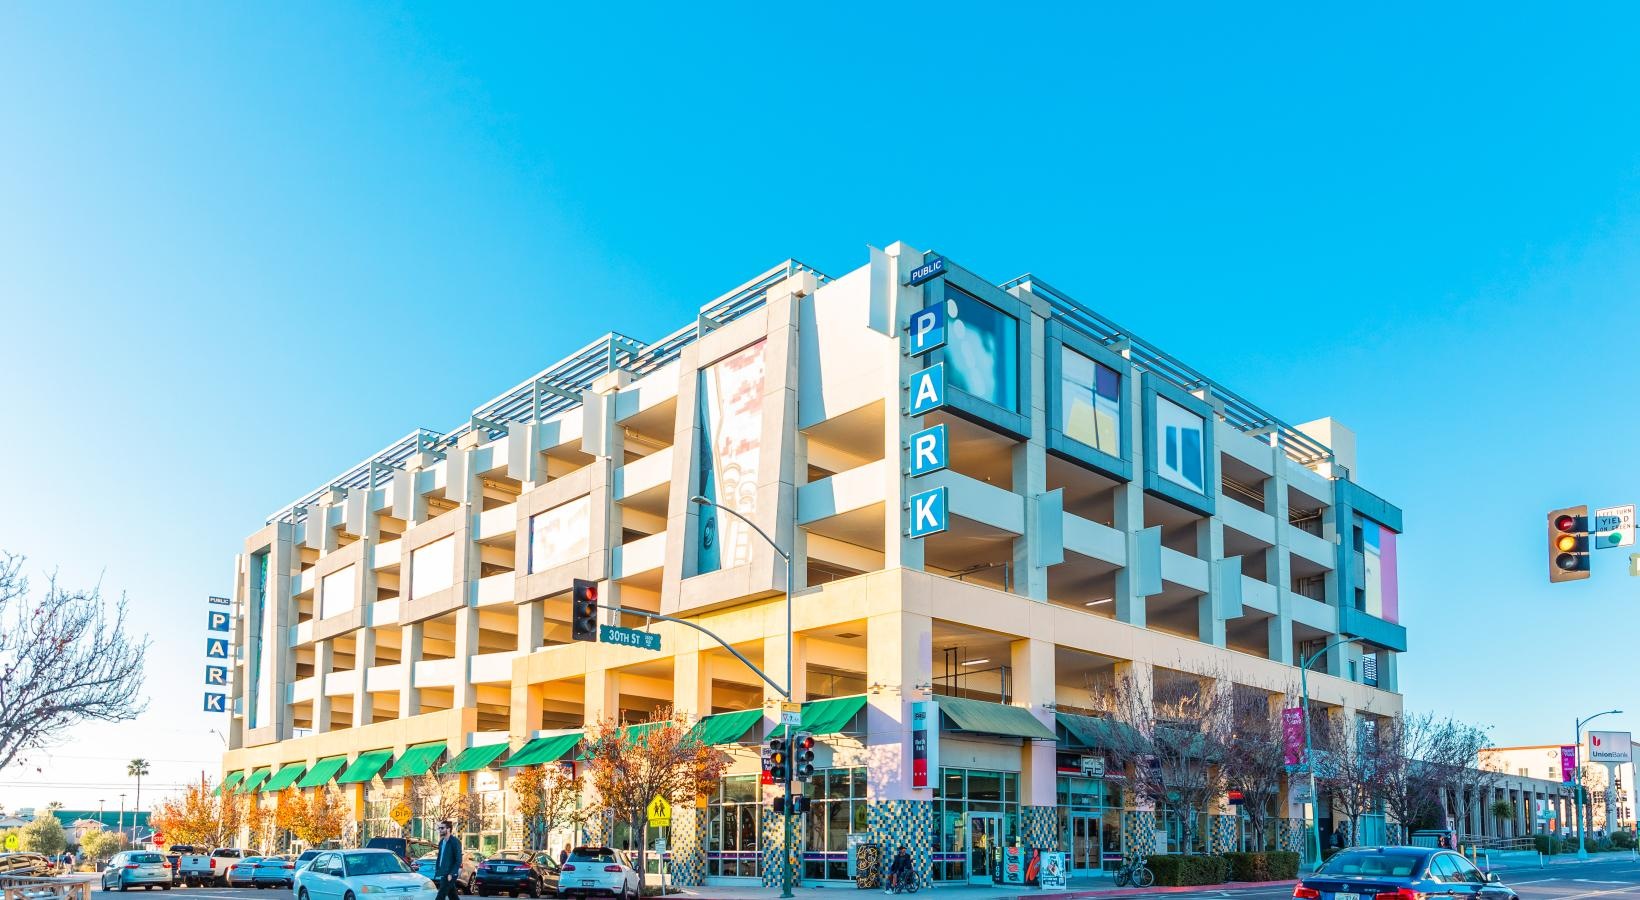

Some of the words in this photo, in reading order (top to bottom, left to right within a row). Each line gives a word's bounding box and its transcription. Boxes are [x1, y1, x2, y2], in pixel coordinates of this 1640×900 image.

[912, 260, 942, 281] PUBLIC
[915, 311, 938, 531] PARK
[1601, 515, 1629, 526] YIELD
[608, 629, 630, 643] 30TH
[631, 633, 640, 645] ST
[207, 613, 226, 711] PARK
[1592, 750, 1629, 758] UnionBank
[395, 809, 408, 818] DIP
